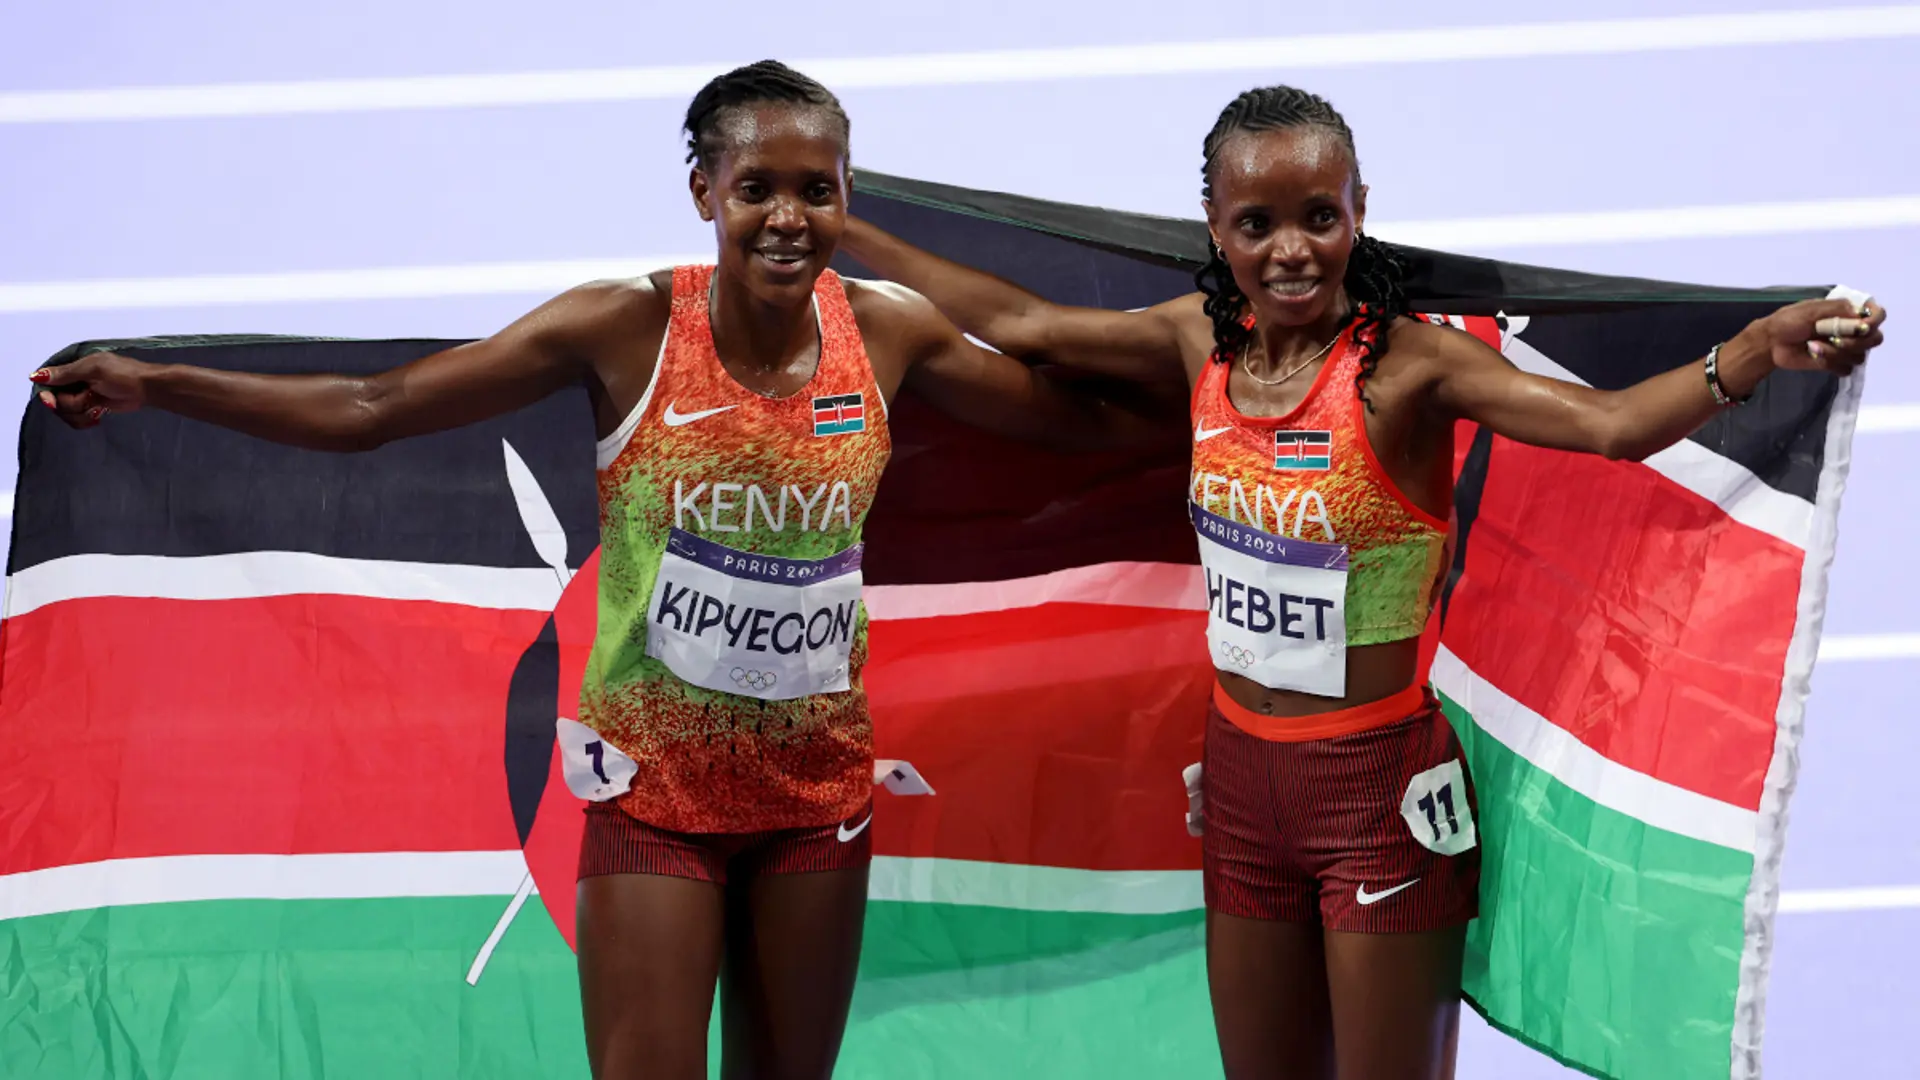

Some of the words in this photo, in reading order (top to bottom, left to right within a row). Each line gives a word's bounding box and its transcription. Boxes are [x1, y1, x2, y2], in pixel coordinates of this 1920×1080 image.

[673, 479, 851, 533] KENYA
[1202, 516, 1240, 543] PARIS
[1244, 533, 1287, 557] 2024
[724, 554, 780, 577] PARIS
[656, 580, 856, 655] KIPYEGON
[1417, 782, 1459, 842] 11
